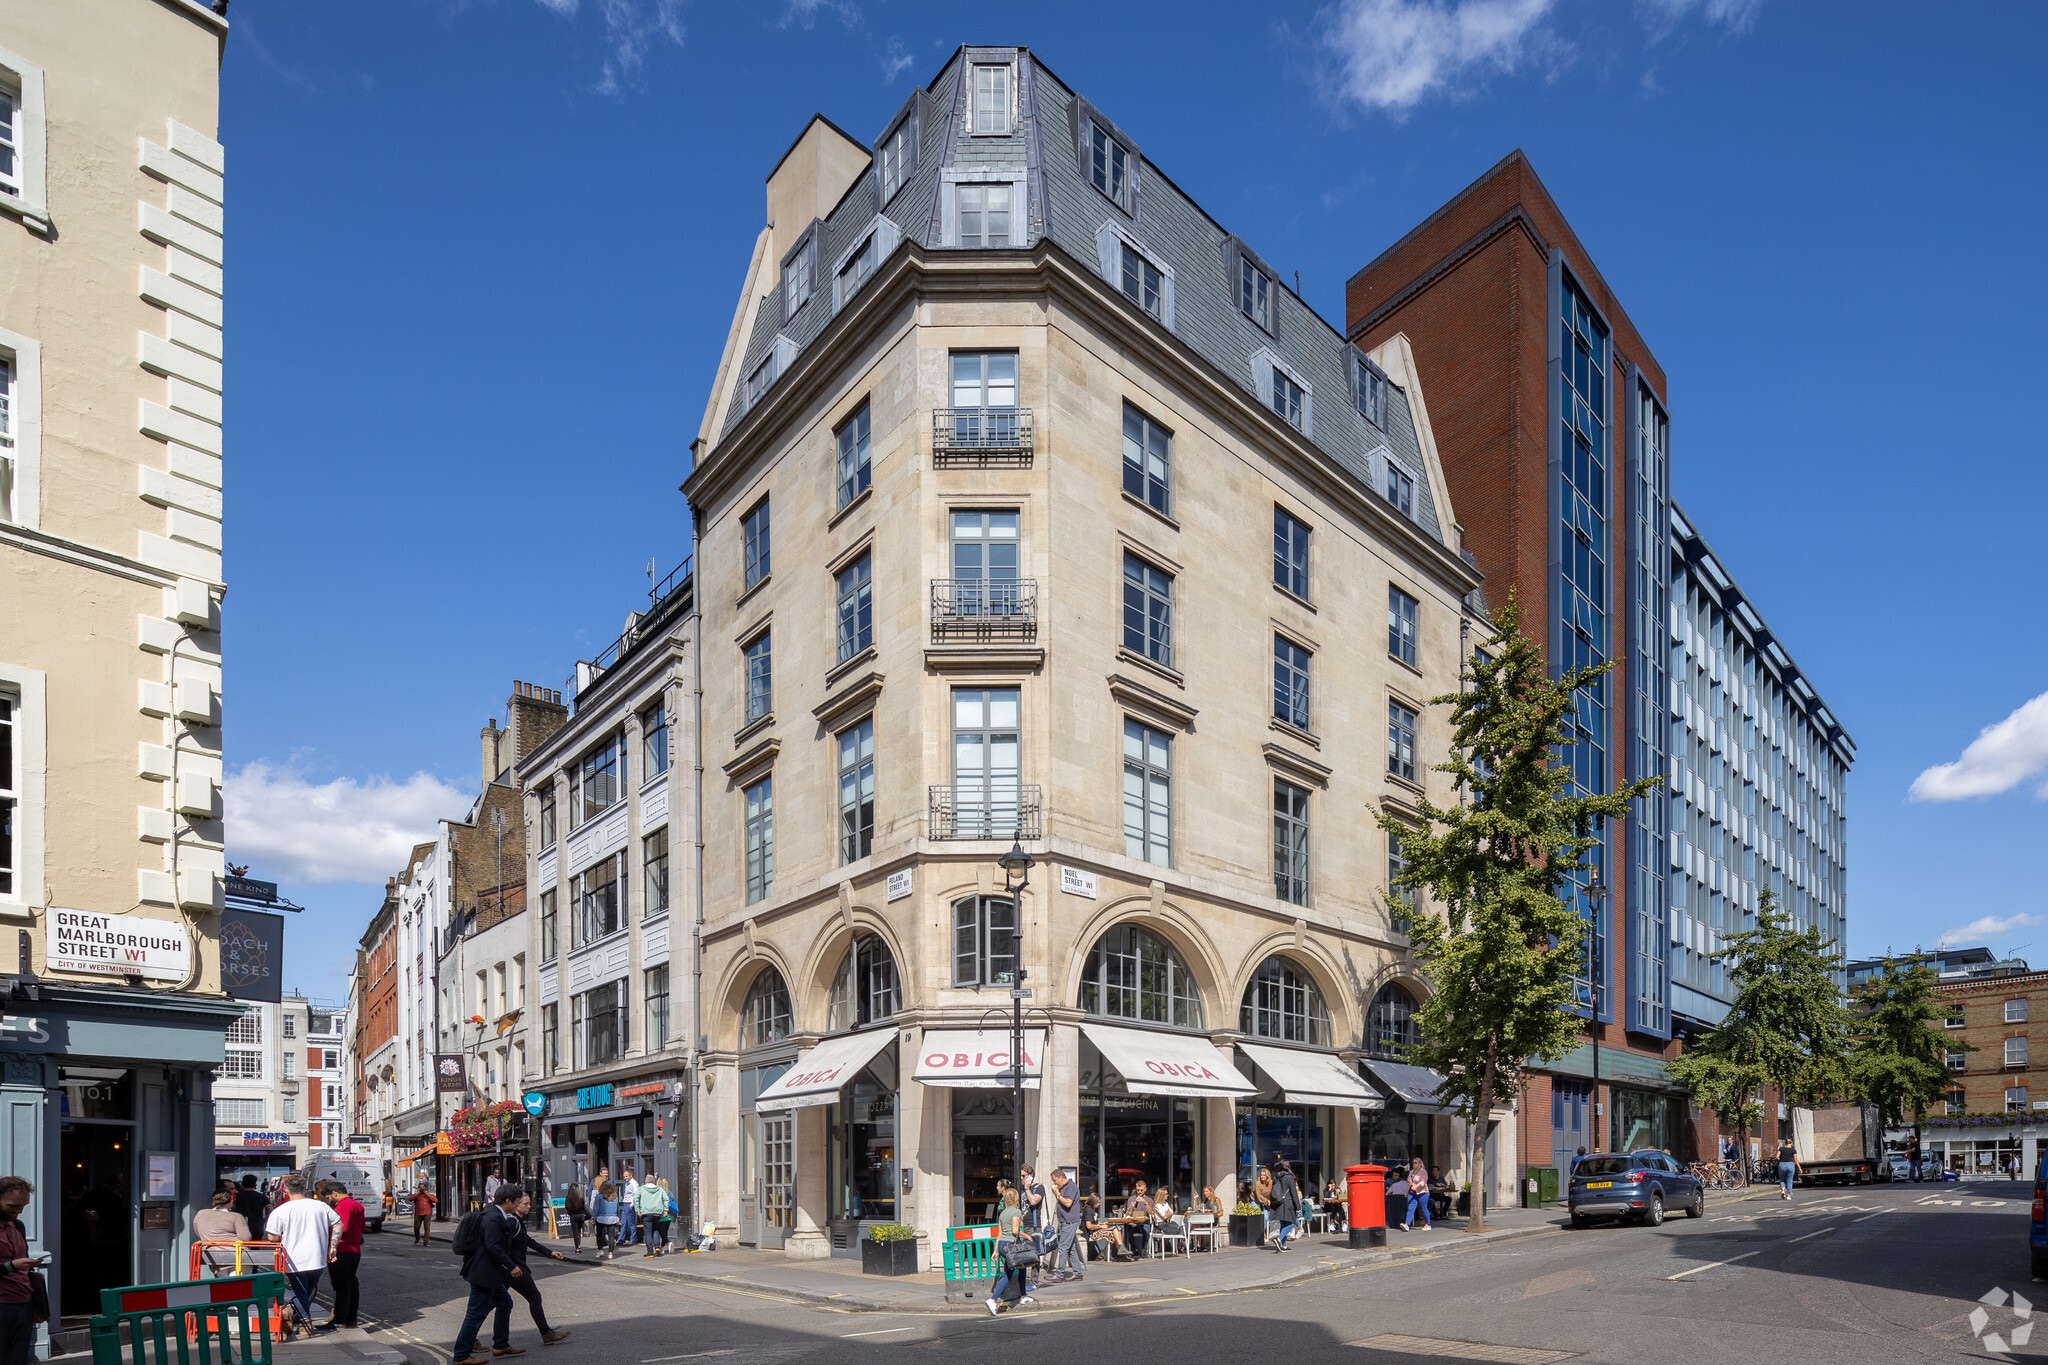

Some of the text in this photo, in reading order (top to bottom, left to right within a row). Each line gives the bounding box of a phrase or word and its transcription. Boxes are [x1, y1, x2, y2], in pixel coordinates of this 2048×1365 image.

[889, 873, 904, 884] POLAND
[1064, 868, 1078, 878] NOEL
[889, 882, 902, 892] STREET
[1064, 876, 1083, 887] STREET
[245, 884, 269, 895] KING
[58, 912, 110, 930] GREAT
[58, 927, 182, 952] MARLBOROUGH
[220, 934, 268, 951] OACH
[58, 942, 146, 962] STREET W1
[230, 949, 240, 960] &
[89, 964, 142, 974] WESTMINSTER
[220, 962, 270, 977] ORSES
[905, 1033, 911, 1042] 19
[577, 1083, 611, 1110] BREWDOG
[1122, 1098, 1159, 1110] CUCINA
[1283, 1110, 1297, 1118] BAR
[244, 1132, 288, 1140] SPORTS
